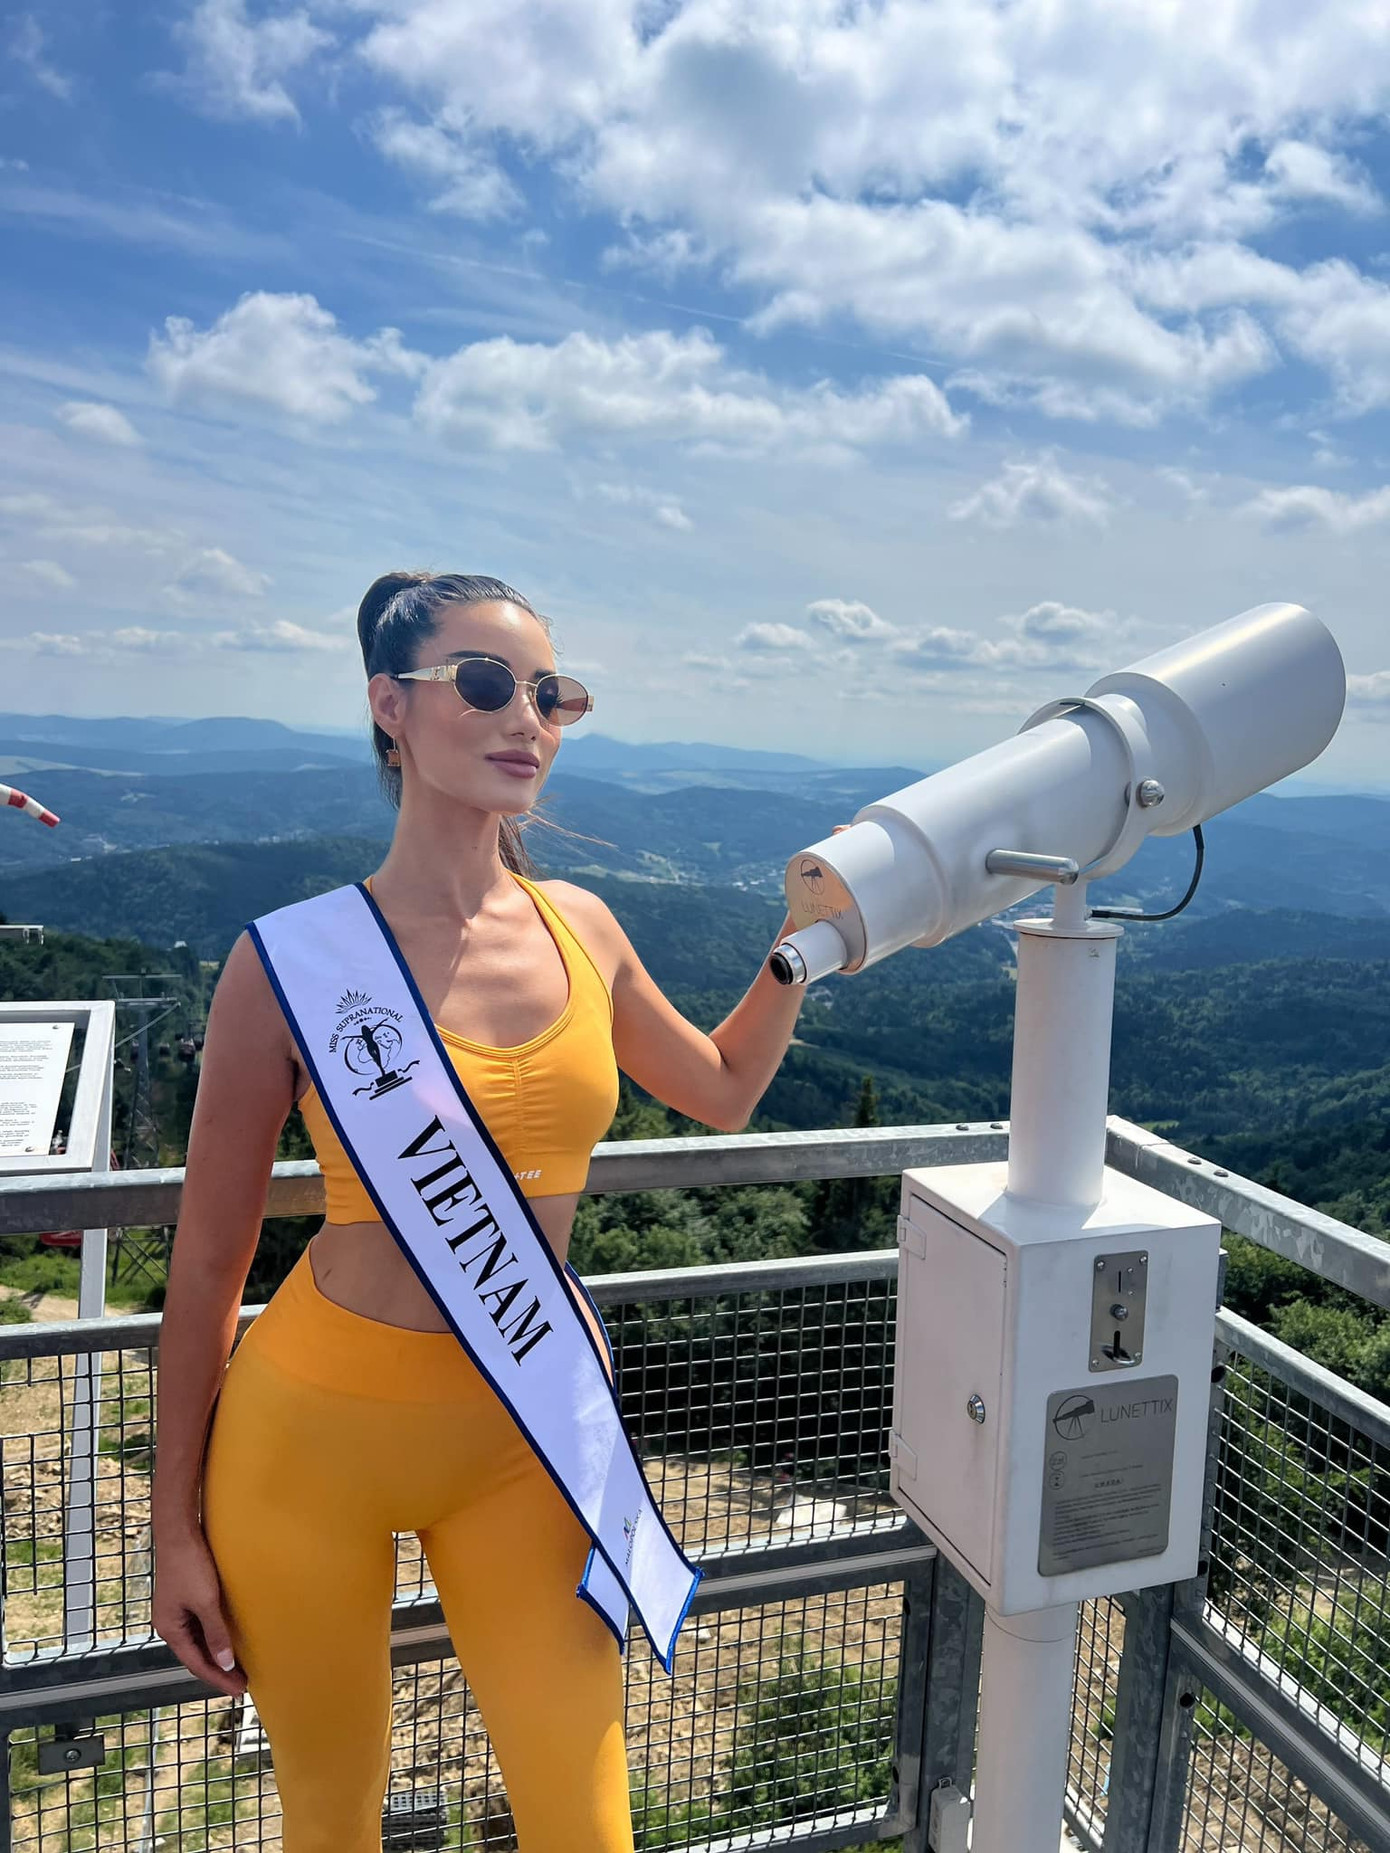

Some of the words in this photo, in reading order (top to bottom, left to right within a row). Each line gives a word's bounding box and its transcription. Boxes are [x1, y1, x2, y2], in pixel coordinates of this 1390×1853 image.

[800, 901, 845, 920] LUNETTIX
[328, 1033, 340, 1053] MISS
[335, 1006, 404, 1033] SUPRANATIONAL
[397, 1114, 554, 1367] VIETNAM
[1100, 1398, 1173, 1424] LUNETTIX
